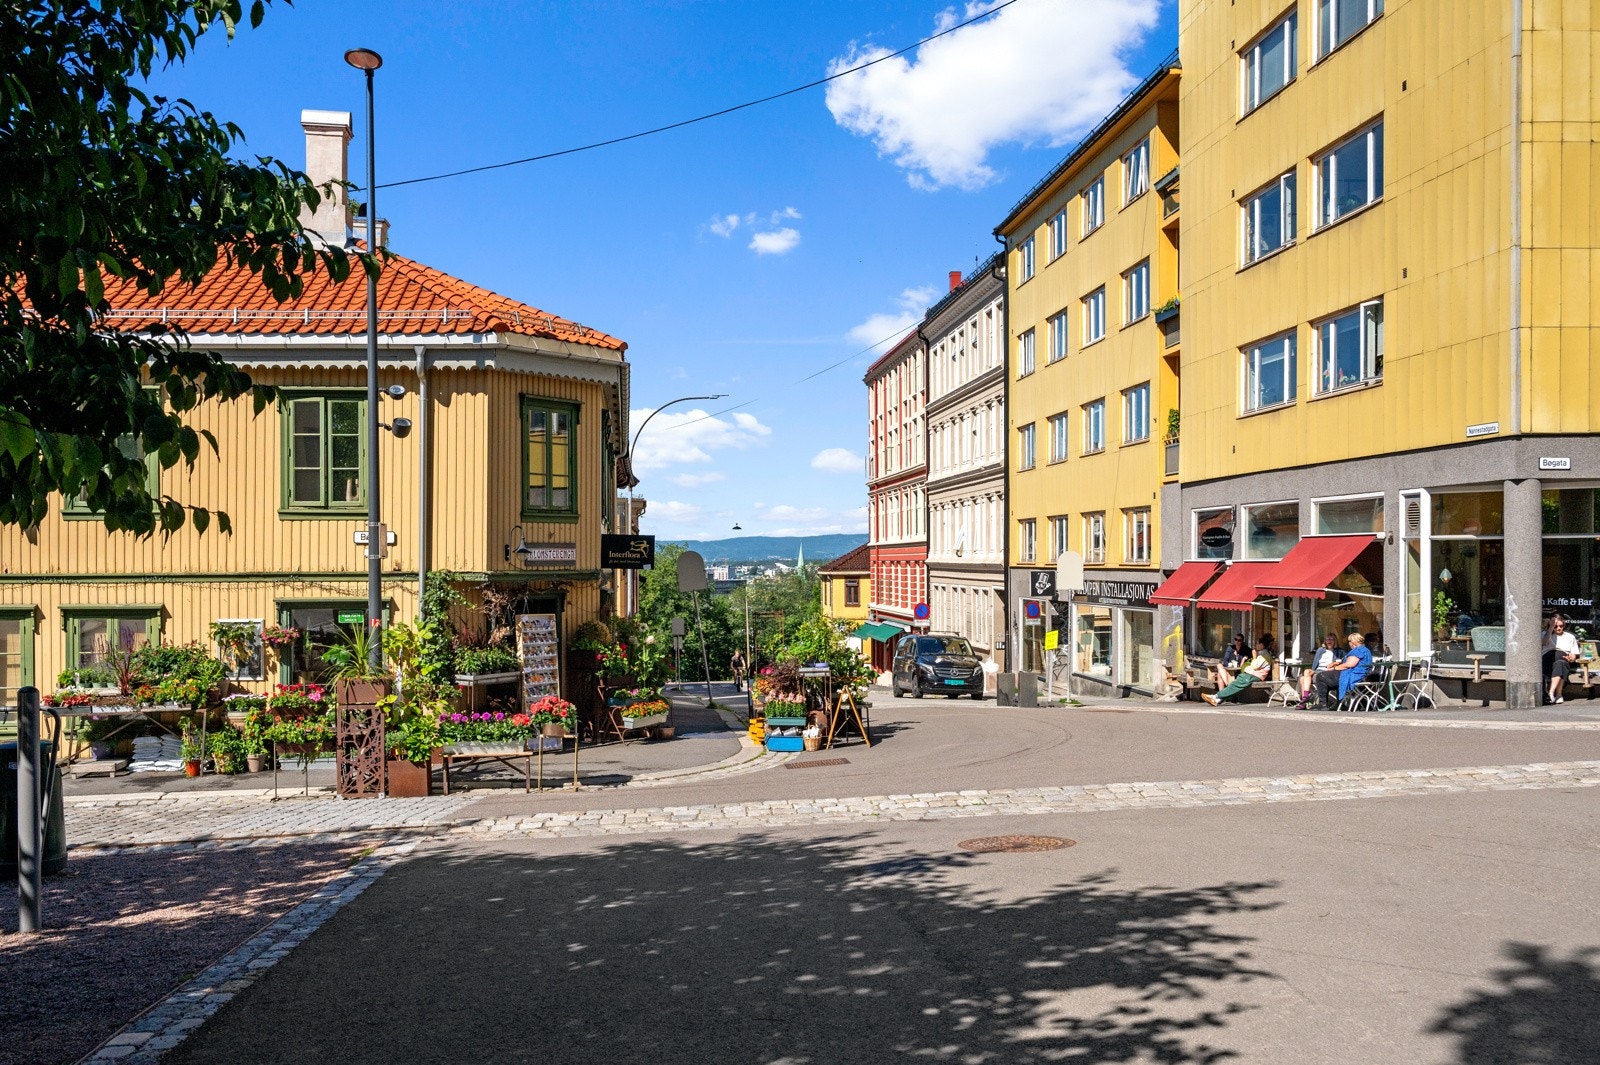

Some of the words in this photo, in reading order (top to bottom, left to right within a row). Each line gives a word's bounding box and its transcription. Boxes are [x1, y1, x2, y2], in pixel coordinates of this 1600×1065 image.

[1542, 459, 1568, 467] Bøgata
[608, 550, 641, 559] Interflora
[1101, 582, 1145, 602] INSTALLASJON
[1145, 584, 1155, 600] AS
[1547, 598, 1569, 606] Kaffe
[1570, 598, 1577, 606] &
[1577, 598, 1593, 606] Bar
